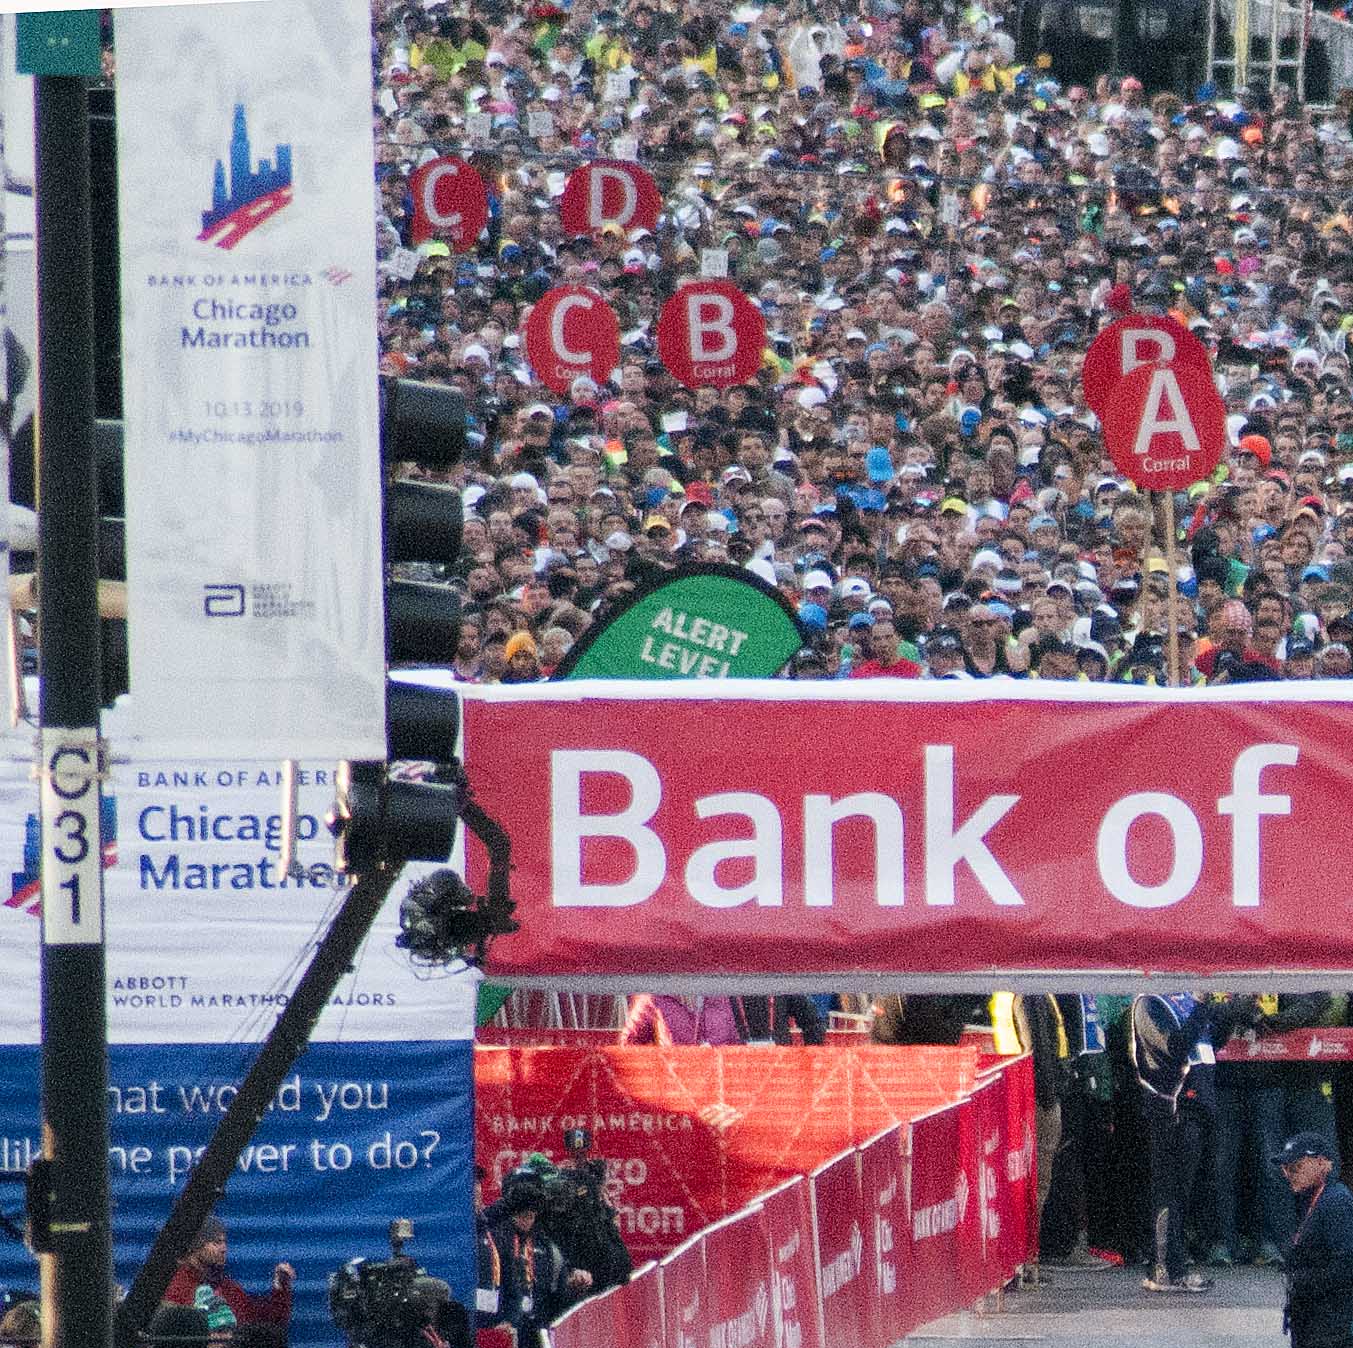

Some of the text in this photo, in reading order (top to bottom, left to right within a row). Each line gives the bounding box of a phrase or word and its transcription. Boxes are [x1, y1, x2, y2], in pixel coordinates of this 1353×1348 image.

[421, 164, 462, 228] C
[592, 167, 638, 229] D
[147, 272, 313, 288] BANK OF AMERICA
[193, 298, 297, 326] Chicago
[551, 295, 593, 364] C
[687, 295, 738, 363] B
[180, 326, 310, 349] Marathon
[1134, 368, 1201, 454] A
[1142, 455, 1190, 474] Corral
[651, 608, 748, 655] ALERT
[138, 771, 249, 788] BANK OF
[138, 805, 319, 851] Chicago
[551, 745, 1025, 912] Bank
[1097, 744, 1300, 912] of
[139, 854, 346, 890] Marato
[113, 975, 188, 991] ABBOTT
[113, 992, 397, 1008] WORLD MARATHO AJORS
[180, 1075, 300, 1113] wod
[316, 1083, 389, 1120] you
[312, 1138, 352, 1170] to
[369, 1130, 440, 1171] do?
